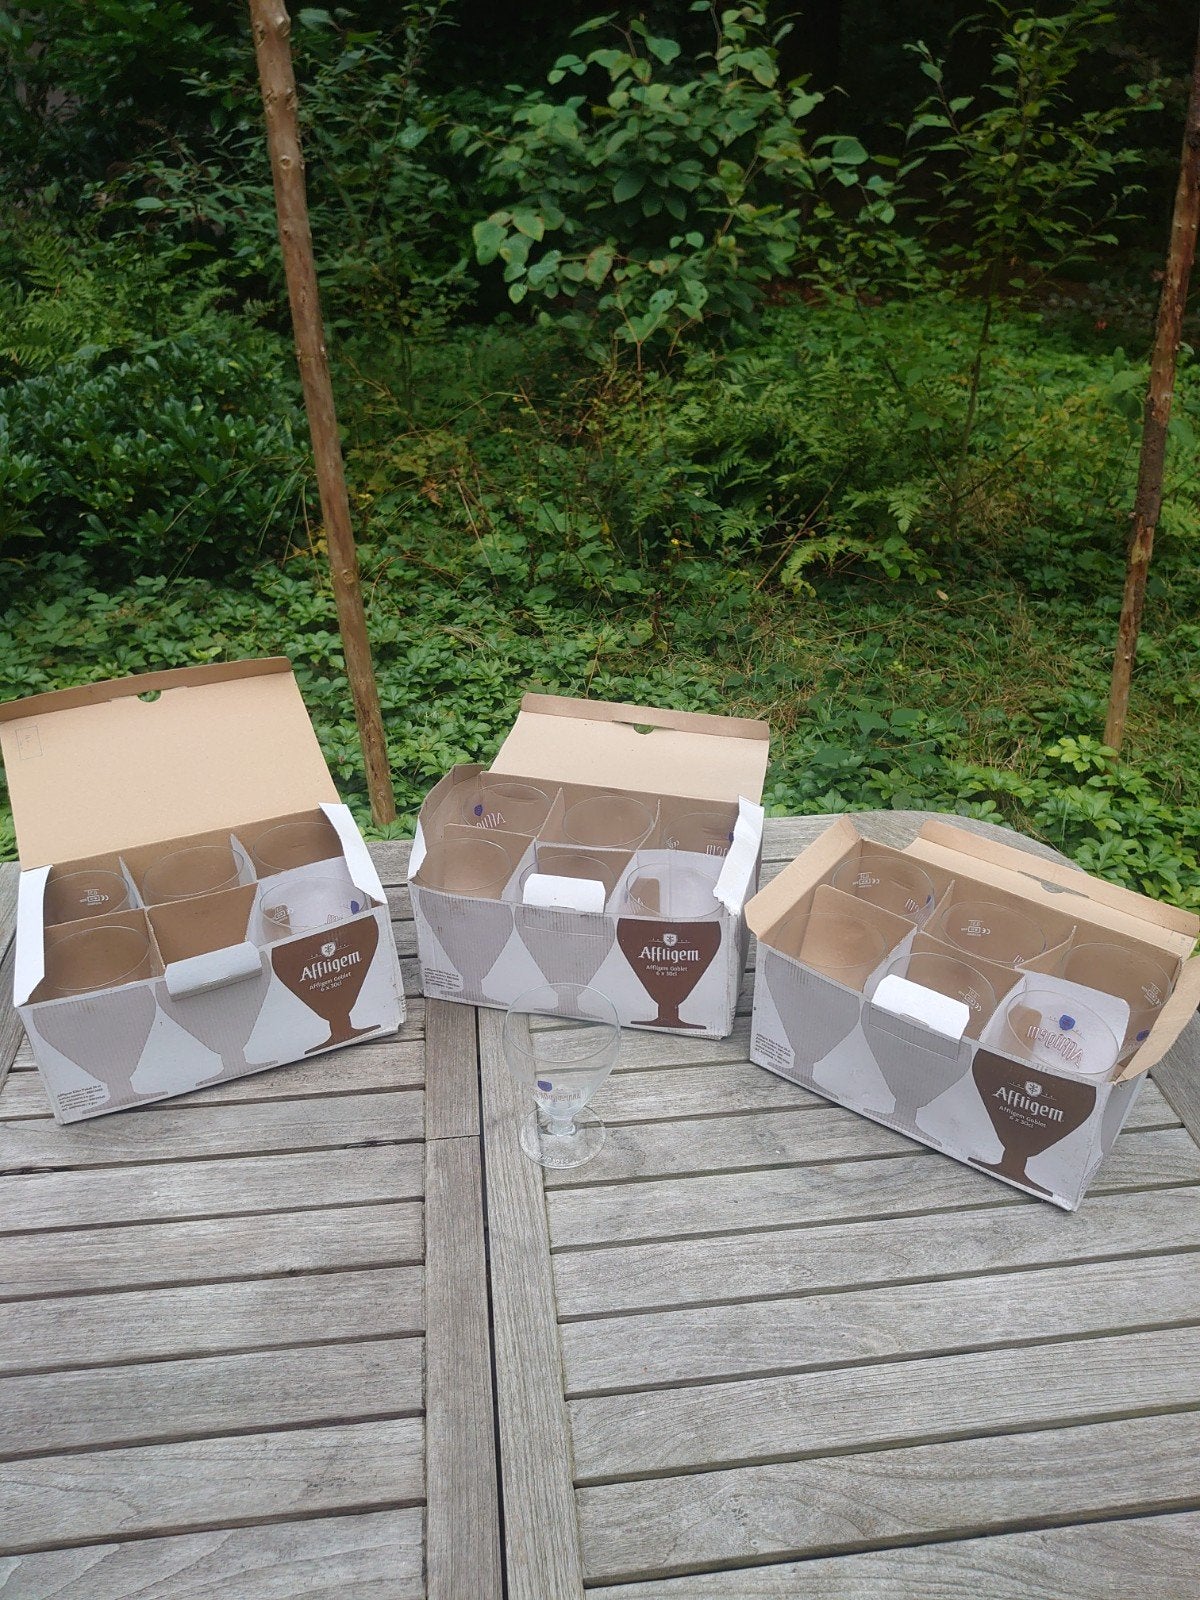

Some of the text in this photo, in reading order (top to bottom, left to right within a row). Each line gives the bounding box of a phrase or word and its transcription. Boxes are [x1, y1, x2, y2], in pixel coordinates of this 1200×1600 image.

[299, 951, 361, 982] Affligem
[637, 946, 699, 963] Affligem
[992, 1086, 1064, 1123] Affligem
